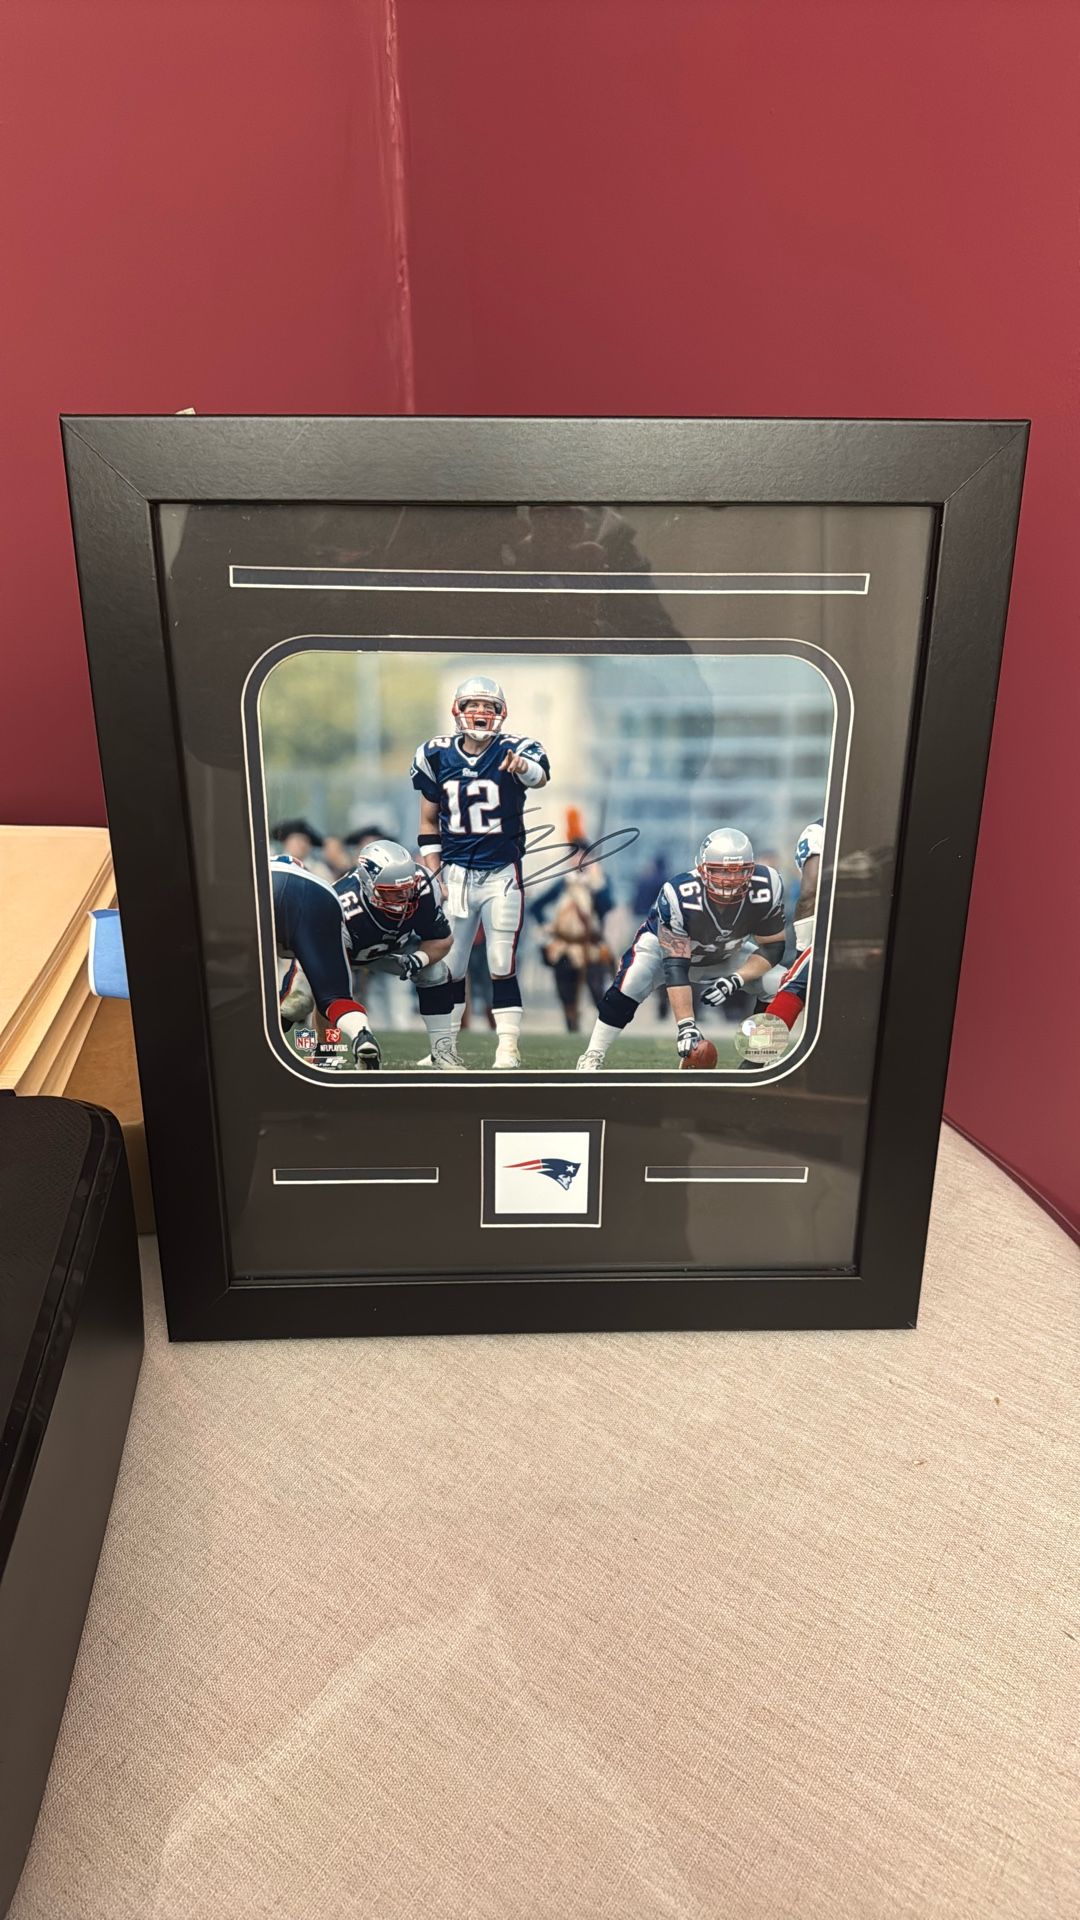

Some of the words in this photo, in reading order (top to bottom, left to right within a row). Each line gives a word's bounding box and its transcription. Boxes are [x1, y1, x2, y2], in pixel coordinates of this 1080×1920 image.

[442, 779, 503, 835] 12
[338, 890, 364, 921] 61
[678, 880, 704, 912] 67
[296, 1036, 316, 1049] NFL
